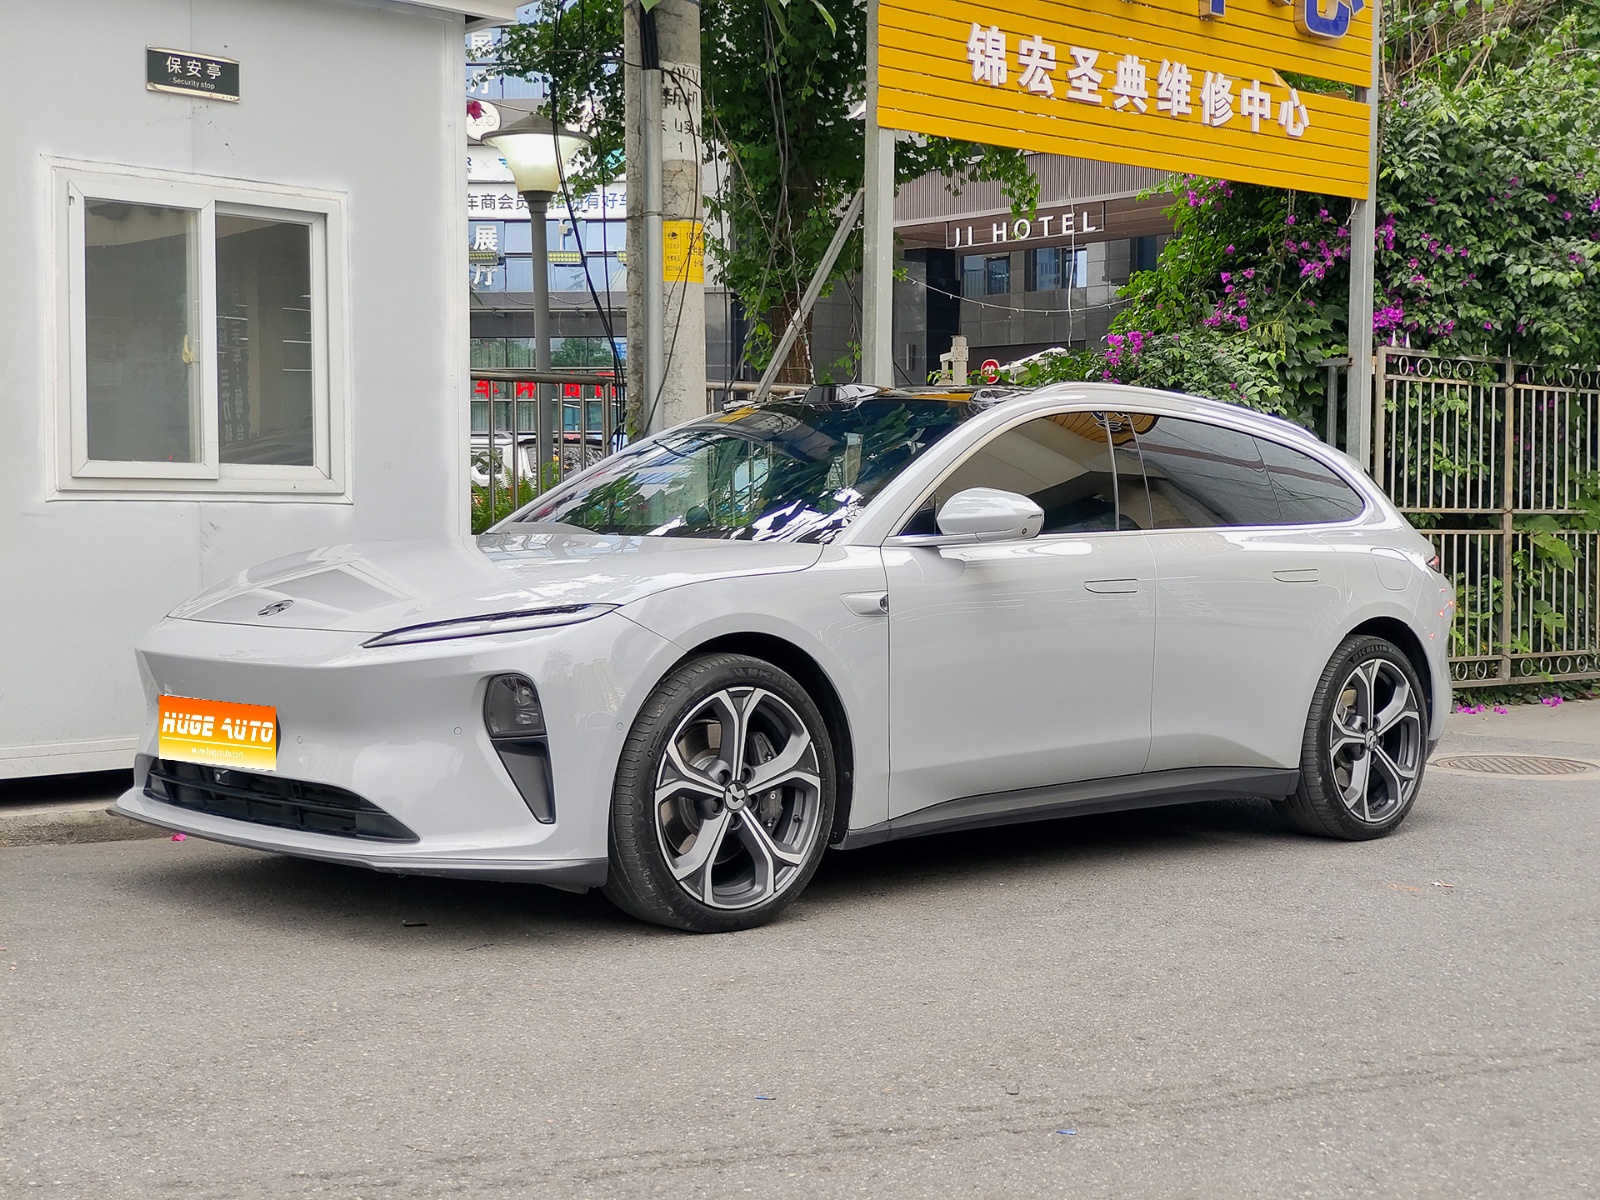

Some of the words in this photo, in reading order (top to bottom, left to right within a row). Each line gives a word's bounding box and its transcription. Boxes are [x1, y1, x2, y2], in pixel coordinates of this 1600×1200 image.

[166, 56, 222, 80] 保安亭
[172, 76, 200, 88] Security
[200, 82, 216, 91] stop
[966, 22, 1311, 137] 锦宏圣典维修中心
[954, 226, 973, 248] JI
[992, 211, 1097, 243] HOTEL
[473, 225, 499, 286] 展厅
